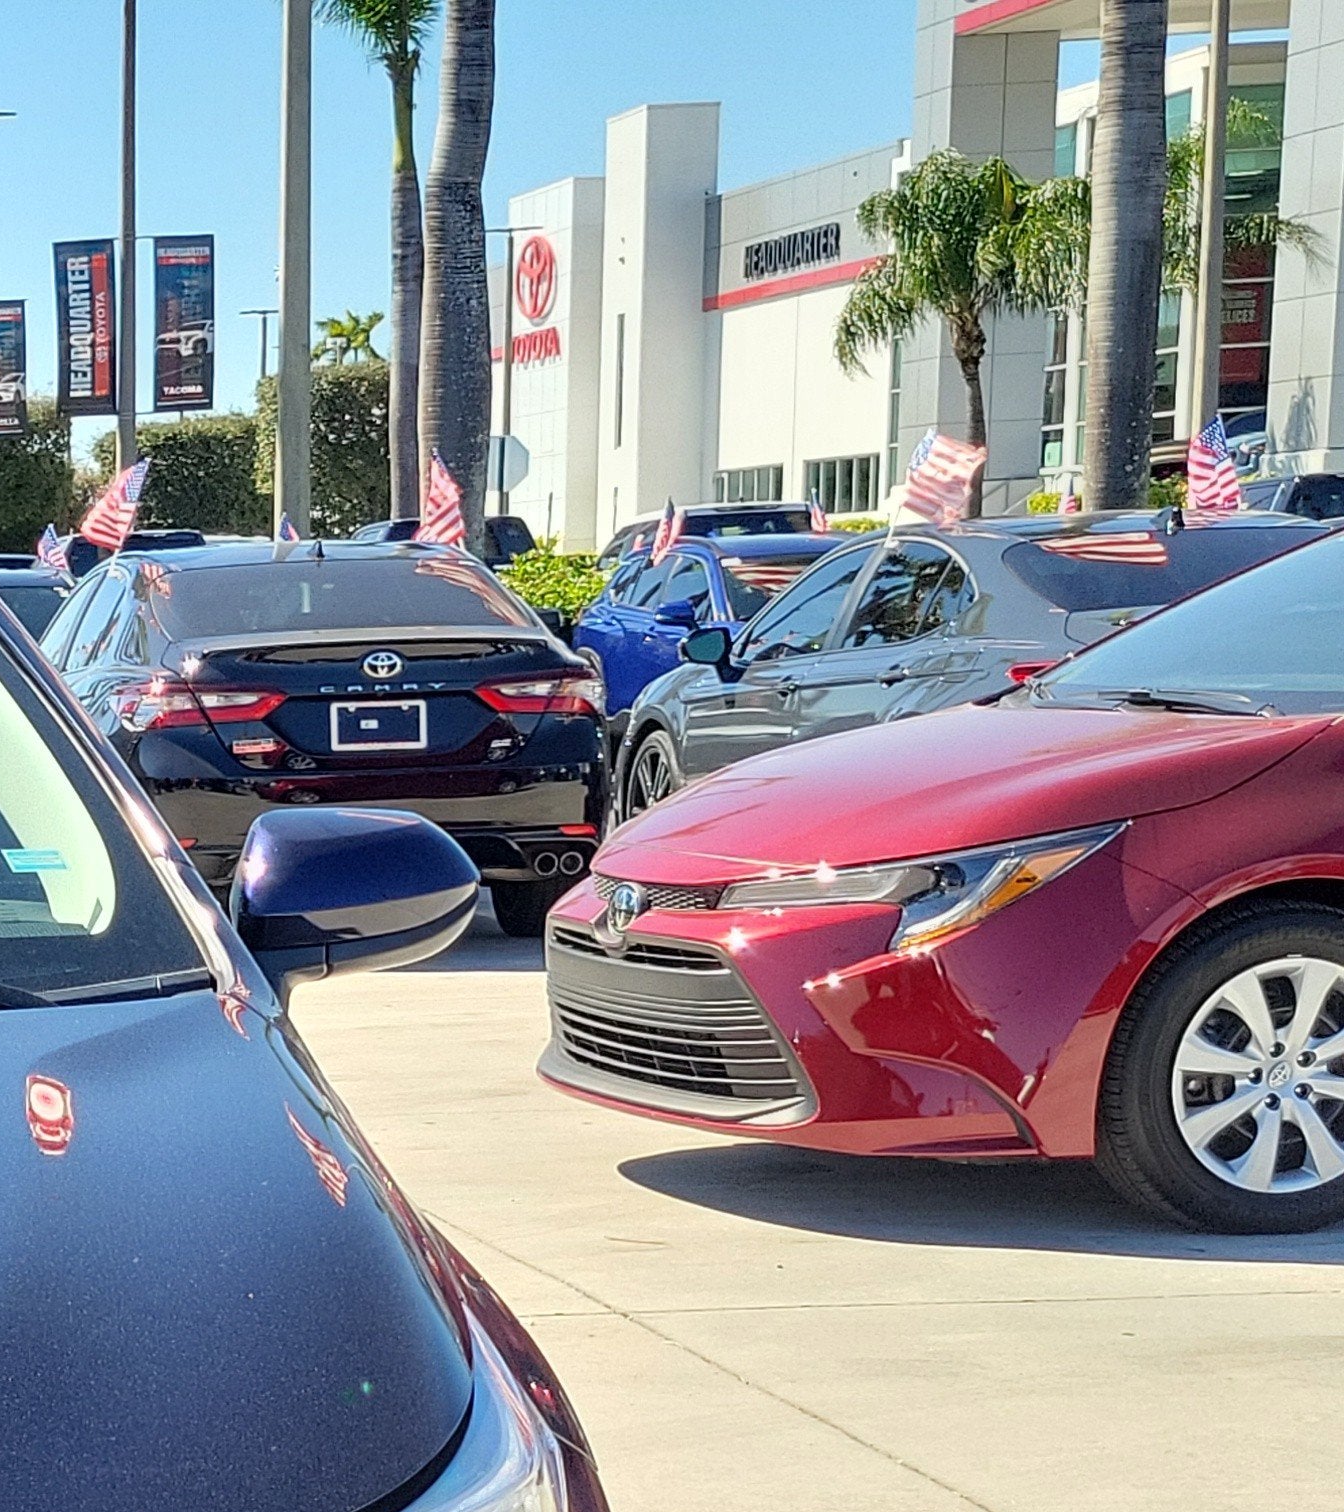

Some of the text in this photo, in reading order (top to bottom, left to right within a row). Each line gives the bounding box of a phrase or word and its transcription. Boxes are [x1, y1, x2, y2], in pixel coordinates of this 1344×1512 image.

[743, 223, 840, 278] HEADQUARTER
[67, 255, 93, 398] HEADQUARTER
[95, 291, 108, 347] TOYOTA
[320, 682, 446, 693] CAMRY
